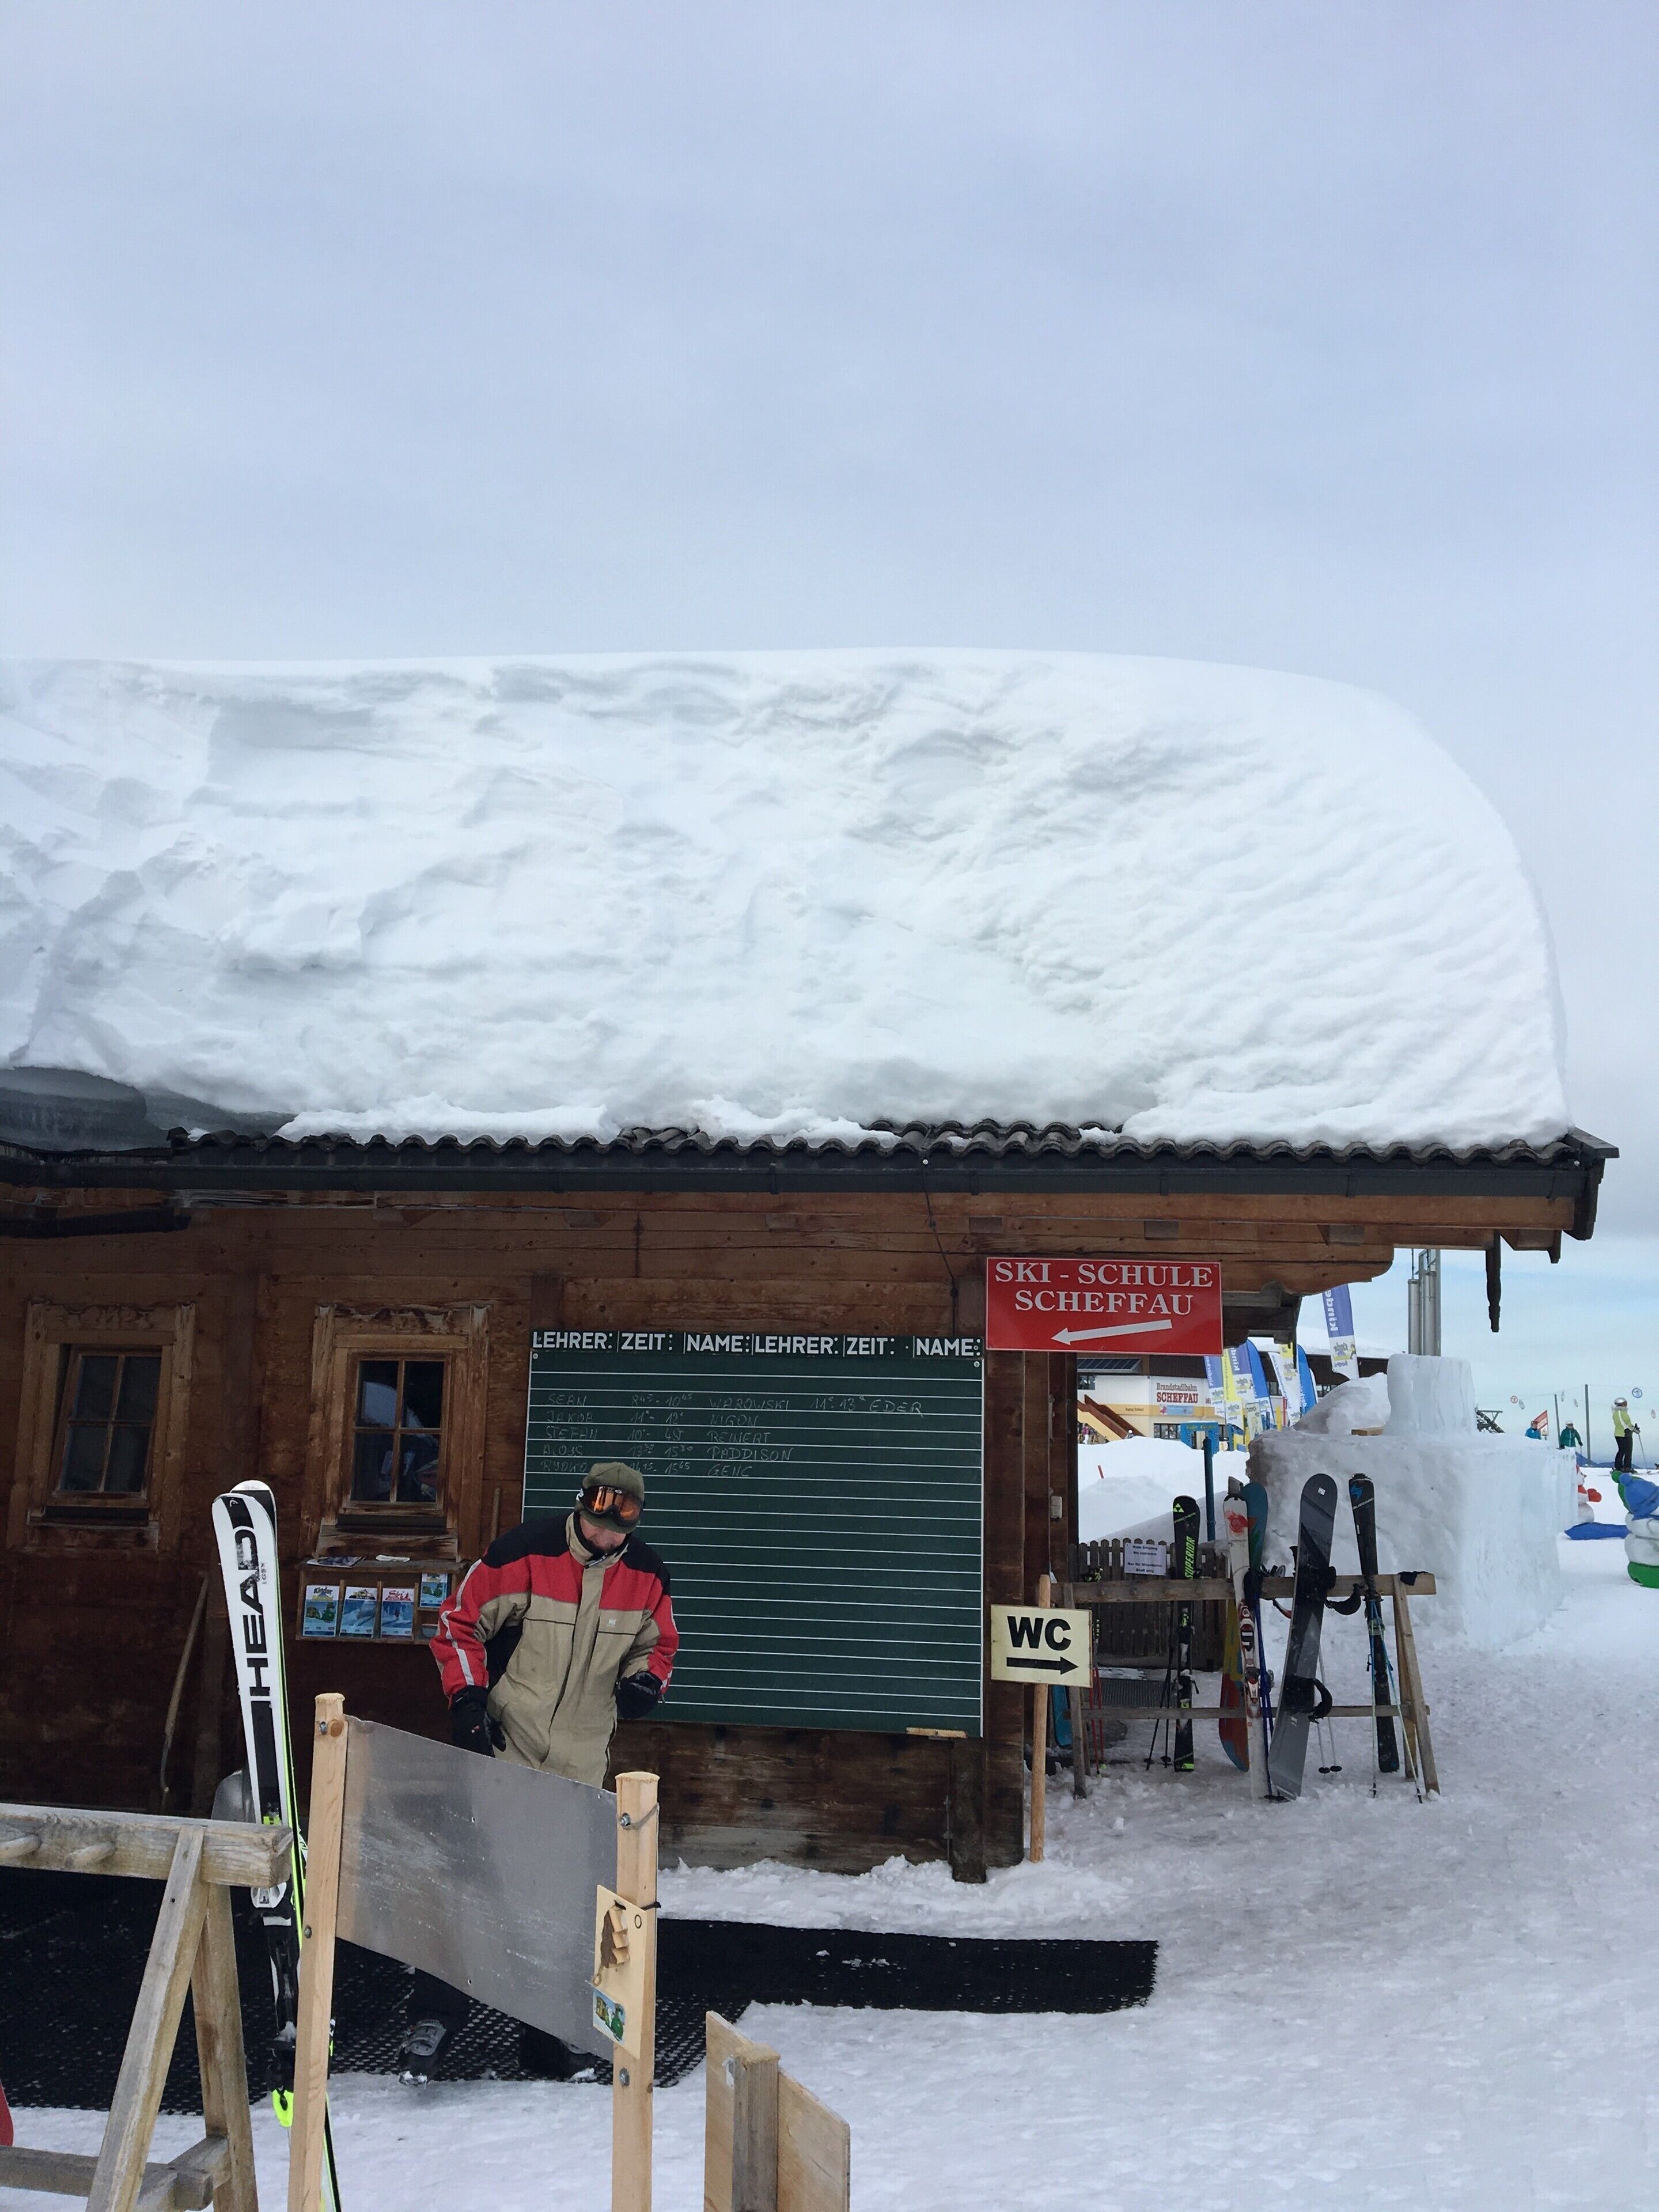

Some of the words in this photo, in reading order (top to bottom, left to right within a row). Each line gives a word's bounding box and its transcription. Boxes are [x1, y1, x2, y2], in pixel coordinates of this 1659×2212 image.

[995, 1262, 1051, 1283] SKI
[1078, 1263, 1213, 1287] SCHULE
[1014, 1290, 1194, 1316] SCHEFFAU
[532, 1331, 613, 1351] LEHRER:
[620, 1334, 674, 1351] ZEIT:
[687, 1335, 751, 1354] NAME:
[755, 1336, 839, 1355] LEHRER:
[847, 1338, 895, 1356] ZEIT:
[916, 1338, 982, 1357] NAME:
[1156, 1382, 1198, 1392] Brandstadlbahn
[1156, 1392, 1199, 1404] SCHEFFAU
[548, 1393, 588, 1406] SEAN
[869, 1399, 924, 1418] EDER
[546, 1426, 599, 1440] STEFAN
[707, 1430, 771, 1444] REINERT
[707, 1446, 794, 1461] PADDISON
[1184, 1535, 1196, 1580] SUPERIOR
[234, 1529, 271, 1696] HEAD
[1007, 1615, 1071, 1652] WC
